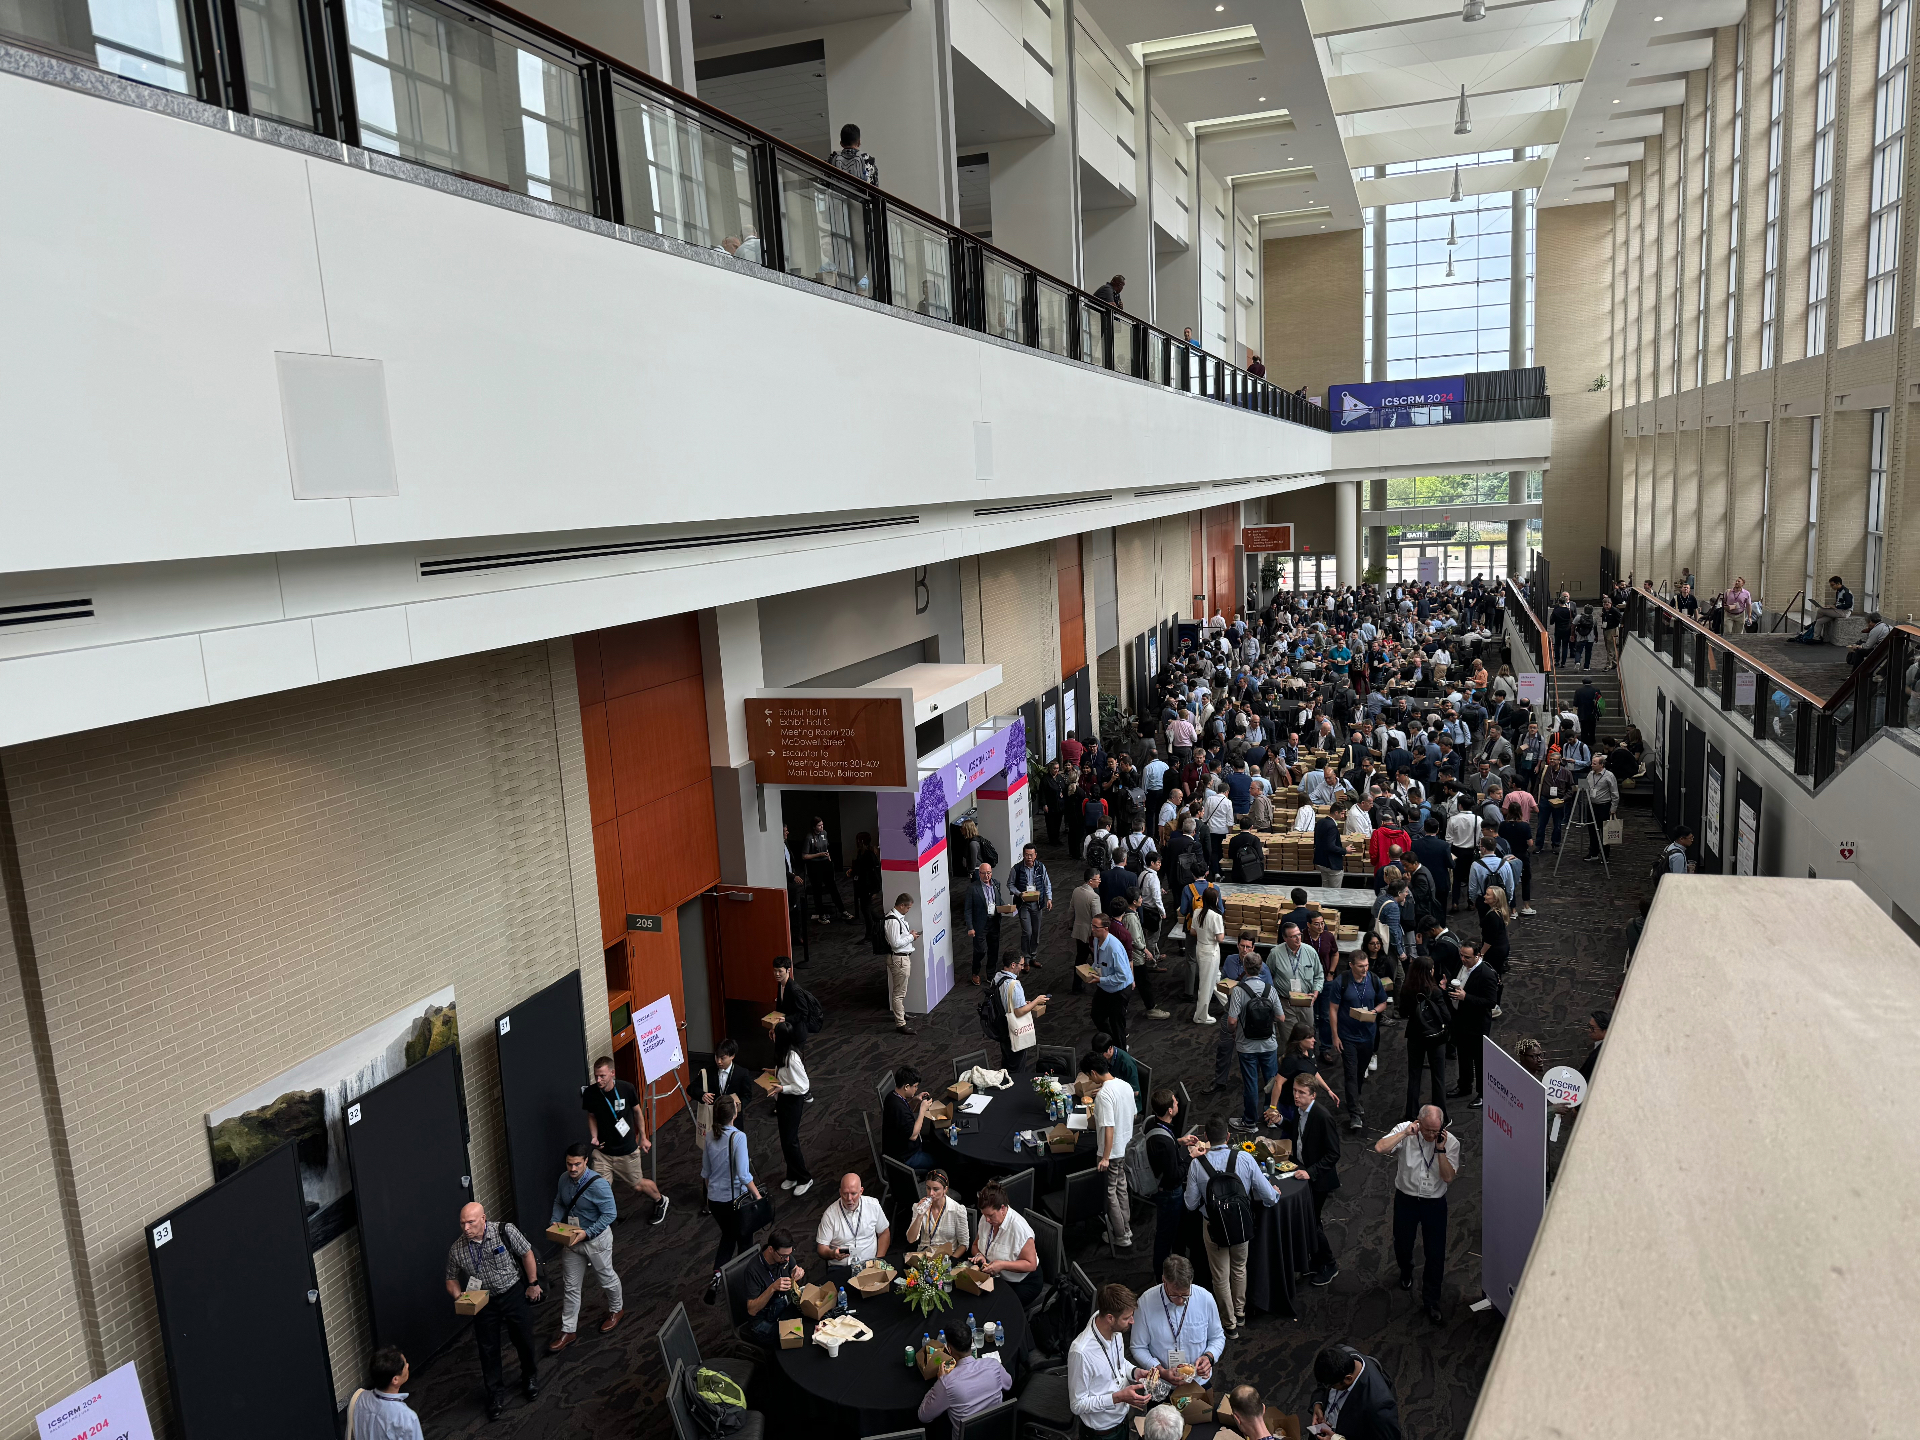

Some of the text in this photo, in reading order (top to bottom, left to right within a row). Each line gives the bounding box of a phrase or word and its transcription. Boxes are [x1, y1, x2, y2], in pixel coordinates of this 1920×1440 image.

[1381, 393, 1454, 407] ICSCRM 2024
[914, 565, 930, 615] B
[779, 708, 804, 716] Exhibit
[806, 708, 821, 716] Hall
[779, 718, 831, 727] Exhibit Hall C
[780, 728, 814, 737] Meeting
[815, 728, 839, 736] Room
[781, 738, 846, 746] McDowell Street
[782, 749, 829, 757] Escalator to
[786, 759, 820, 769] Meeting
[821, 760, 849, 768] Rooms
[787, 769, 873, 778] Main Lobby, Ballroom
[635, 918, 653, 928] 205
[500, 1021, 508, 1031] 31
[1487, 1072, 1509, 1098] ICSCRM
[1510, 1092, 1524, 1111] 2024
[1549, 1078, 1581, 1093] ICSCRM
[1546, 1086, 1578, 1103] 2024
[348, 1108, 359, 1121] 32
[1487, 1104, 1513, 1139] LUNCH
[155, 1226, 169, 1242] 33
[47, 1393, 102, 1430] ICSCRM 2024
[89, 1418, 110, 1437] 204
